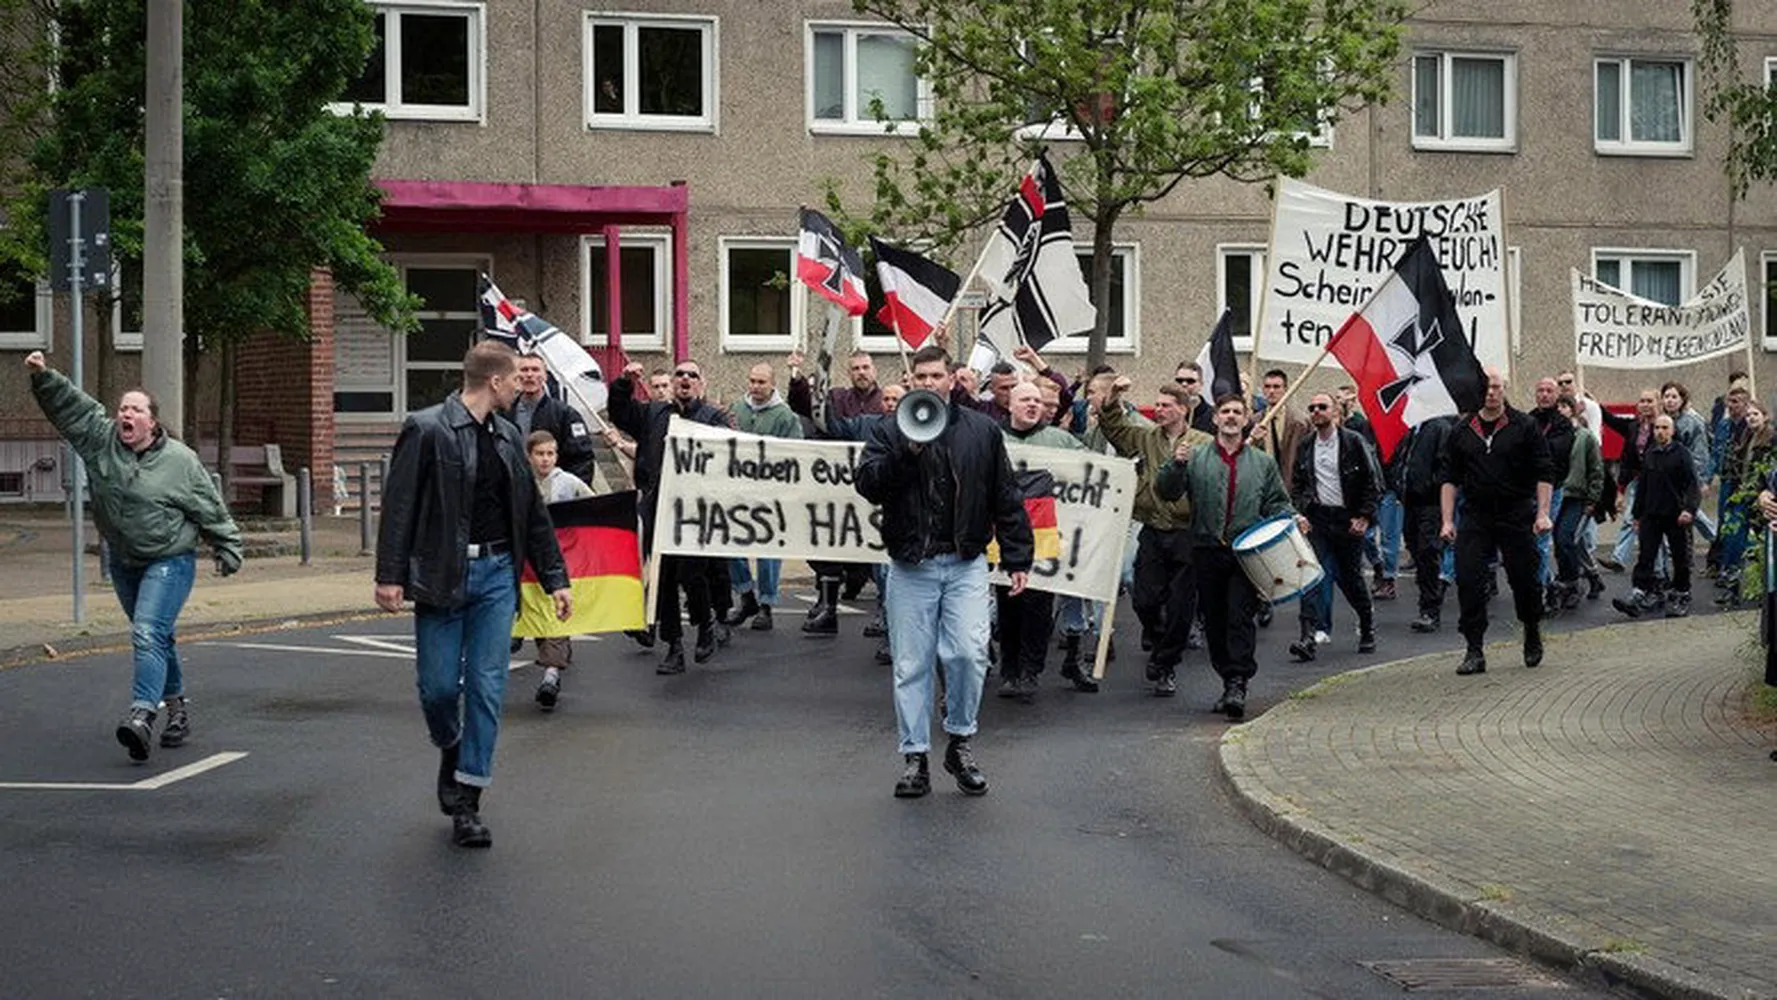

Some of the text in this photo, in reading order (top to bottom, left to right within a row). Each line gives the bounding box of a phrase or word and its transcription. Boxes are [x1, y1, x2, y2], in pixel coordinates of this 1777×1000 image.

[1344, 200, 1488, 238] DEUTSCHE
[1438, 234, 1498, 271] EUCH!
[1578, 332, 1645, 358] FREMD
[669, 436, 715, 475] Wir
[727, 437, 801, 484] haben
[673, 497, 787, 550] HASS!
